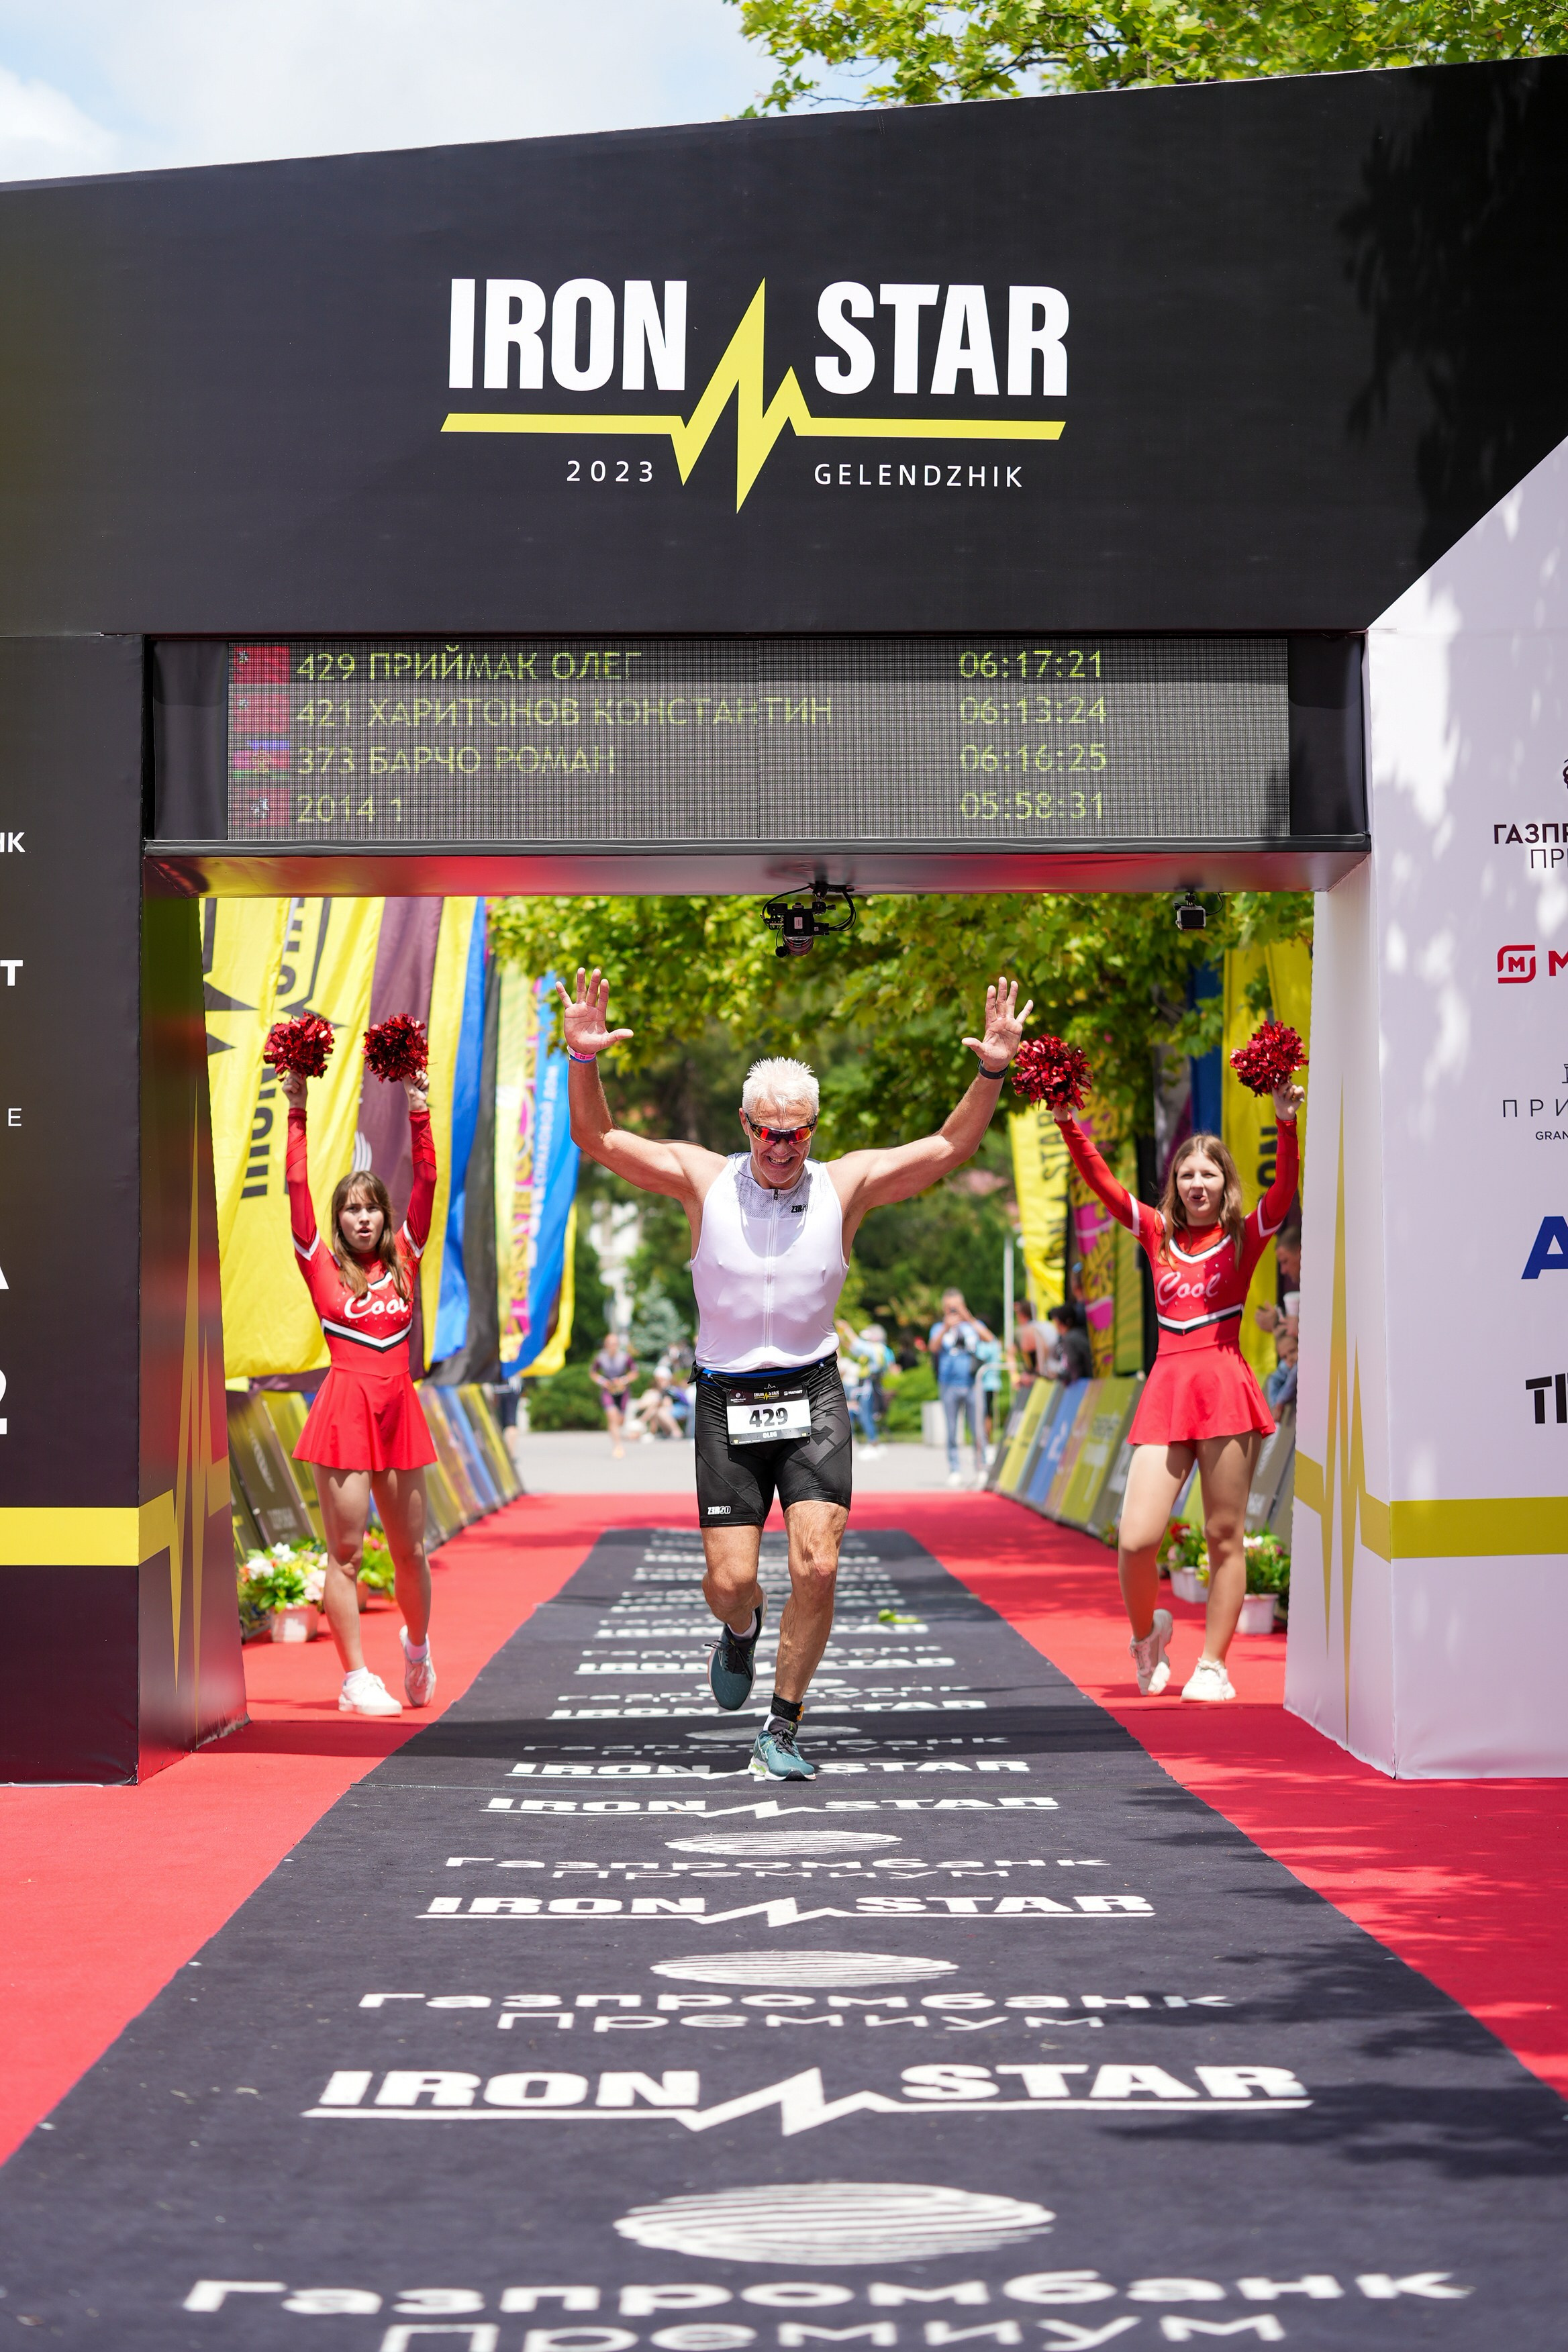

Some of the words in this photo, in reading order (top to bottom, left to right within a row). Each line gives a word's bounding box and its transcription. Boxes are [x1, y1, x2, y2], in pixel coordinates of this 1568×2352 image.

[448, 278, 688, 391] IRON
[815, 281, 1071, 397] STAR
[567, 460, 654, 483] 2023
[814, 462, 1024, 487] GELENDZHIK
[296, 652, 356, 680] 429
[370, 644, 538, 680] ПРИЙМАК
[550, 652, 642, 680] ОЛЕГ
[959, 650, 1102, 679] 06:17:21
[296, 699, 351, 727] 421
[367, 698, 581, 727] ХАРИТОНОВ
[594, 697, 832, 726] КОНСТАНТИН
[960, 695, 1107, 724] 06:13:24
[297, 746, 355, 775] 373
[370, 746, 481, 775] БАРЧО
[496, 745, 615, 774] РОМАН
[960, 744, 1107, 773] 06:16:25
[297, 795, 377, 823] 2014
[390, 795, 401, 822] 1
[960, 791, 1103, 820] 05:58:31
[1530, 848, 1568, 869] ПР
[1157, 1271, 1221, 1306] Cool
[344, 1290, 409, 1319] Cool
[1526, 1373, 1568, 1424] TI
[749, 1407, 788, 1428] 429
[762, 1430, 778, 1438] OLEG
[552, 1707, 720, 1717] IRON
[809, 1700, 987, 1712] STAR
[601, 1746, 934, 1756] Преиум
[511, 1763, 710, 1775] IRON
[818, 1760, 1030, 1773] STAR
[487, 1798, 706, 1812] IRON
[825, 1796, 1059, 1810] STAR
[445, 1857, 1112, 1871] Газпромбанк
[552, 1869, 1010, 1880] Премиум
[426, 1897, 706, 1914] IRON
[856, 1896, 1155, 1913] STAR
[358, 1992, 1235, 2011] Газпромбанк
[496, 2012, 1104, 2032] Премиум
[318, 2070, 699, 2108] IRON
[900, 2063, 1308, 2100] STAR
[182, 2271, 1475, 2317] Газпромбанк
[378, 2312, 1287, 2352] Премиум
